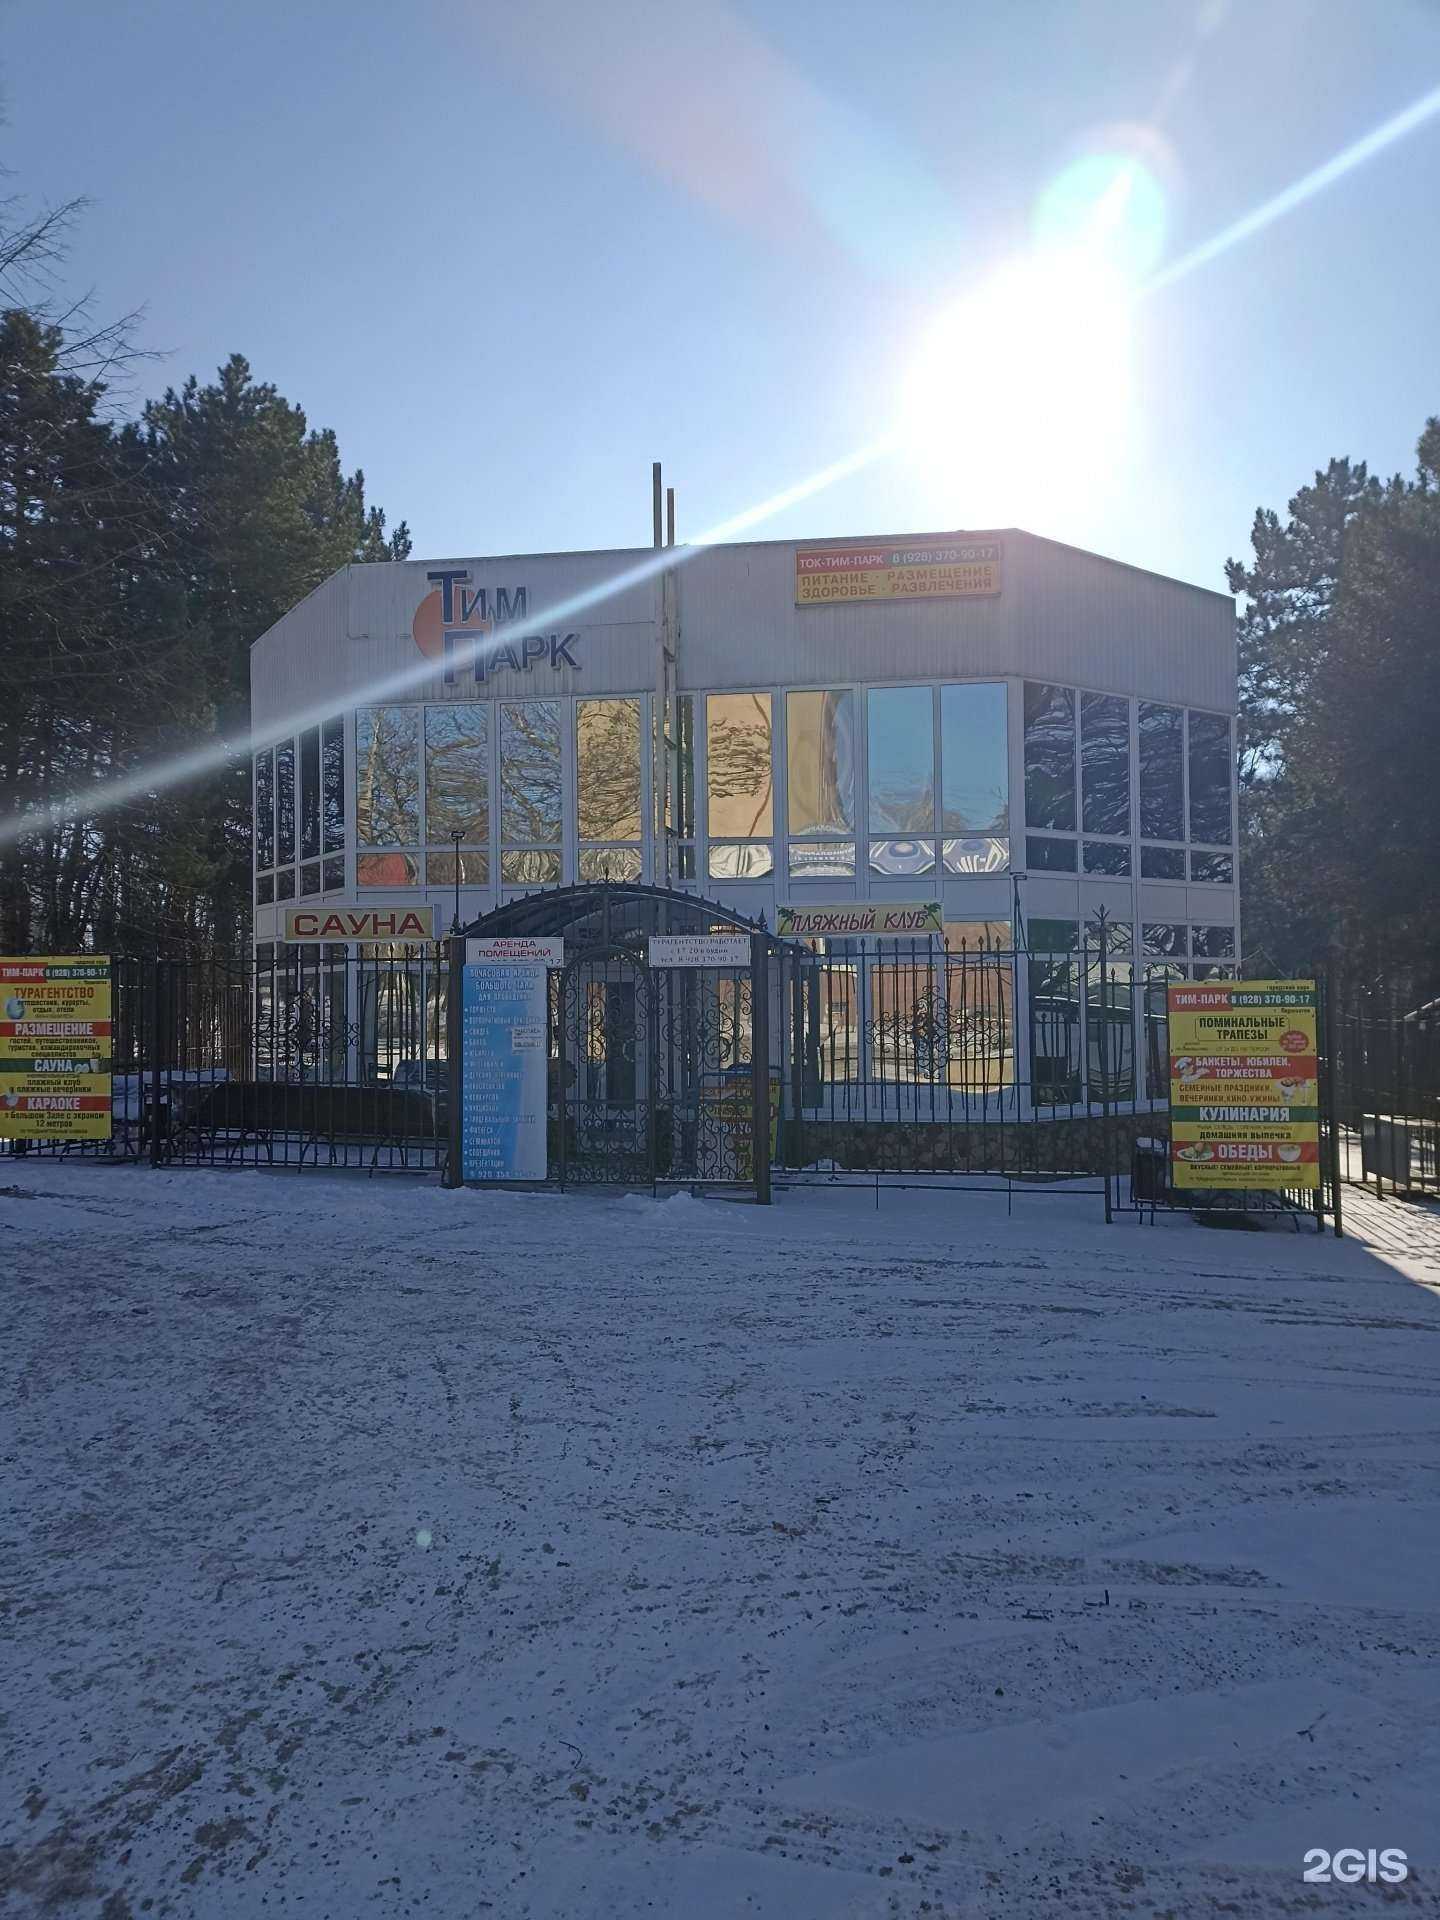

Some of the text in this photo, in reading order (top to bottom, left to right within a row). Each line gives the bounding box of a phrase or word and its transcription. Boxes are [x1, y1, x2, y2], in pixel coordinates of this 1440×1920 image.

[802, 566, 992, 586] ПИТАНИЕ РАЗМЕЩЕНИЕ
[802, 578, 992, 599] ЗДОРОВЬЕ РАЗВЛЕЧЕНИЯ
[444, 630, 577, 684] ПАРК
[294, 913, 425, 935] САУНА
[791, 908, 929, 931] ПЛЯЖНЫЙ КЛУБ
[493, 940, 536, 948] АРЕНДА
[479, 949, 551, 957] ПОМЕЩЕНИЙ
[2, 968, 44, 977] ТИМ-ПАРК
[14, 987, 95, 998] ТУРАГЕНТСТВО
[1175, 994, 1228, 1004] ТИМ-ПАРК
[1199, 1017, 1286, 1027] ПОМИНАЛЬНЫЕ
[15, 1023, 94, 1036] РАЗМЕЩЕНИЕ
[1217, 1030, 1268, 1039] ТРАПЕЗЫ
[34, 1059, 73, 1071] САУНА
[1216, 1069, 1272, 1078] ТОРЖЕСТВА
[1179, 1084, 1221, 1092] СЕМЕЙНЫЕ
[28, 1098, 80, 1109] КАРАОКЕ
[1200, 1107, 1290, 1121] КУЛИНАРИЯ
[1218, 1145, 1273, 1161] ОБЕДЫ
